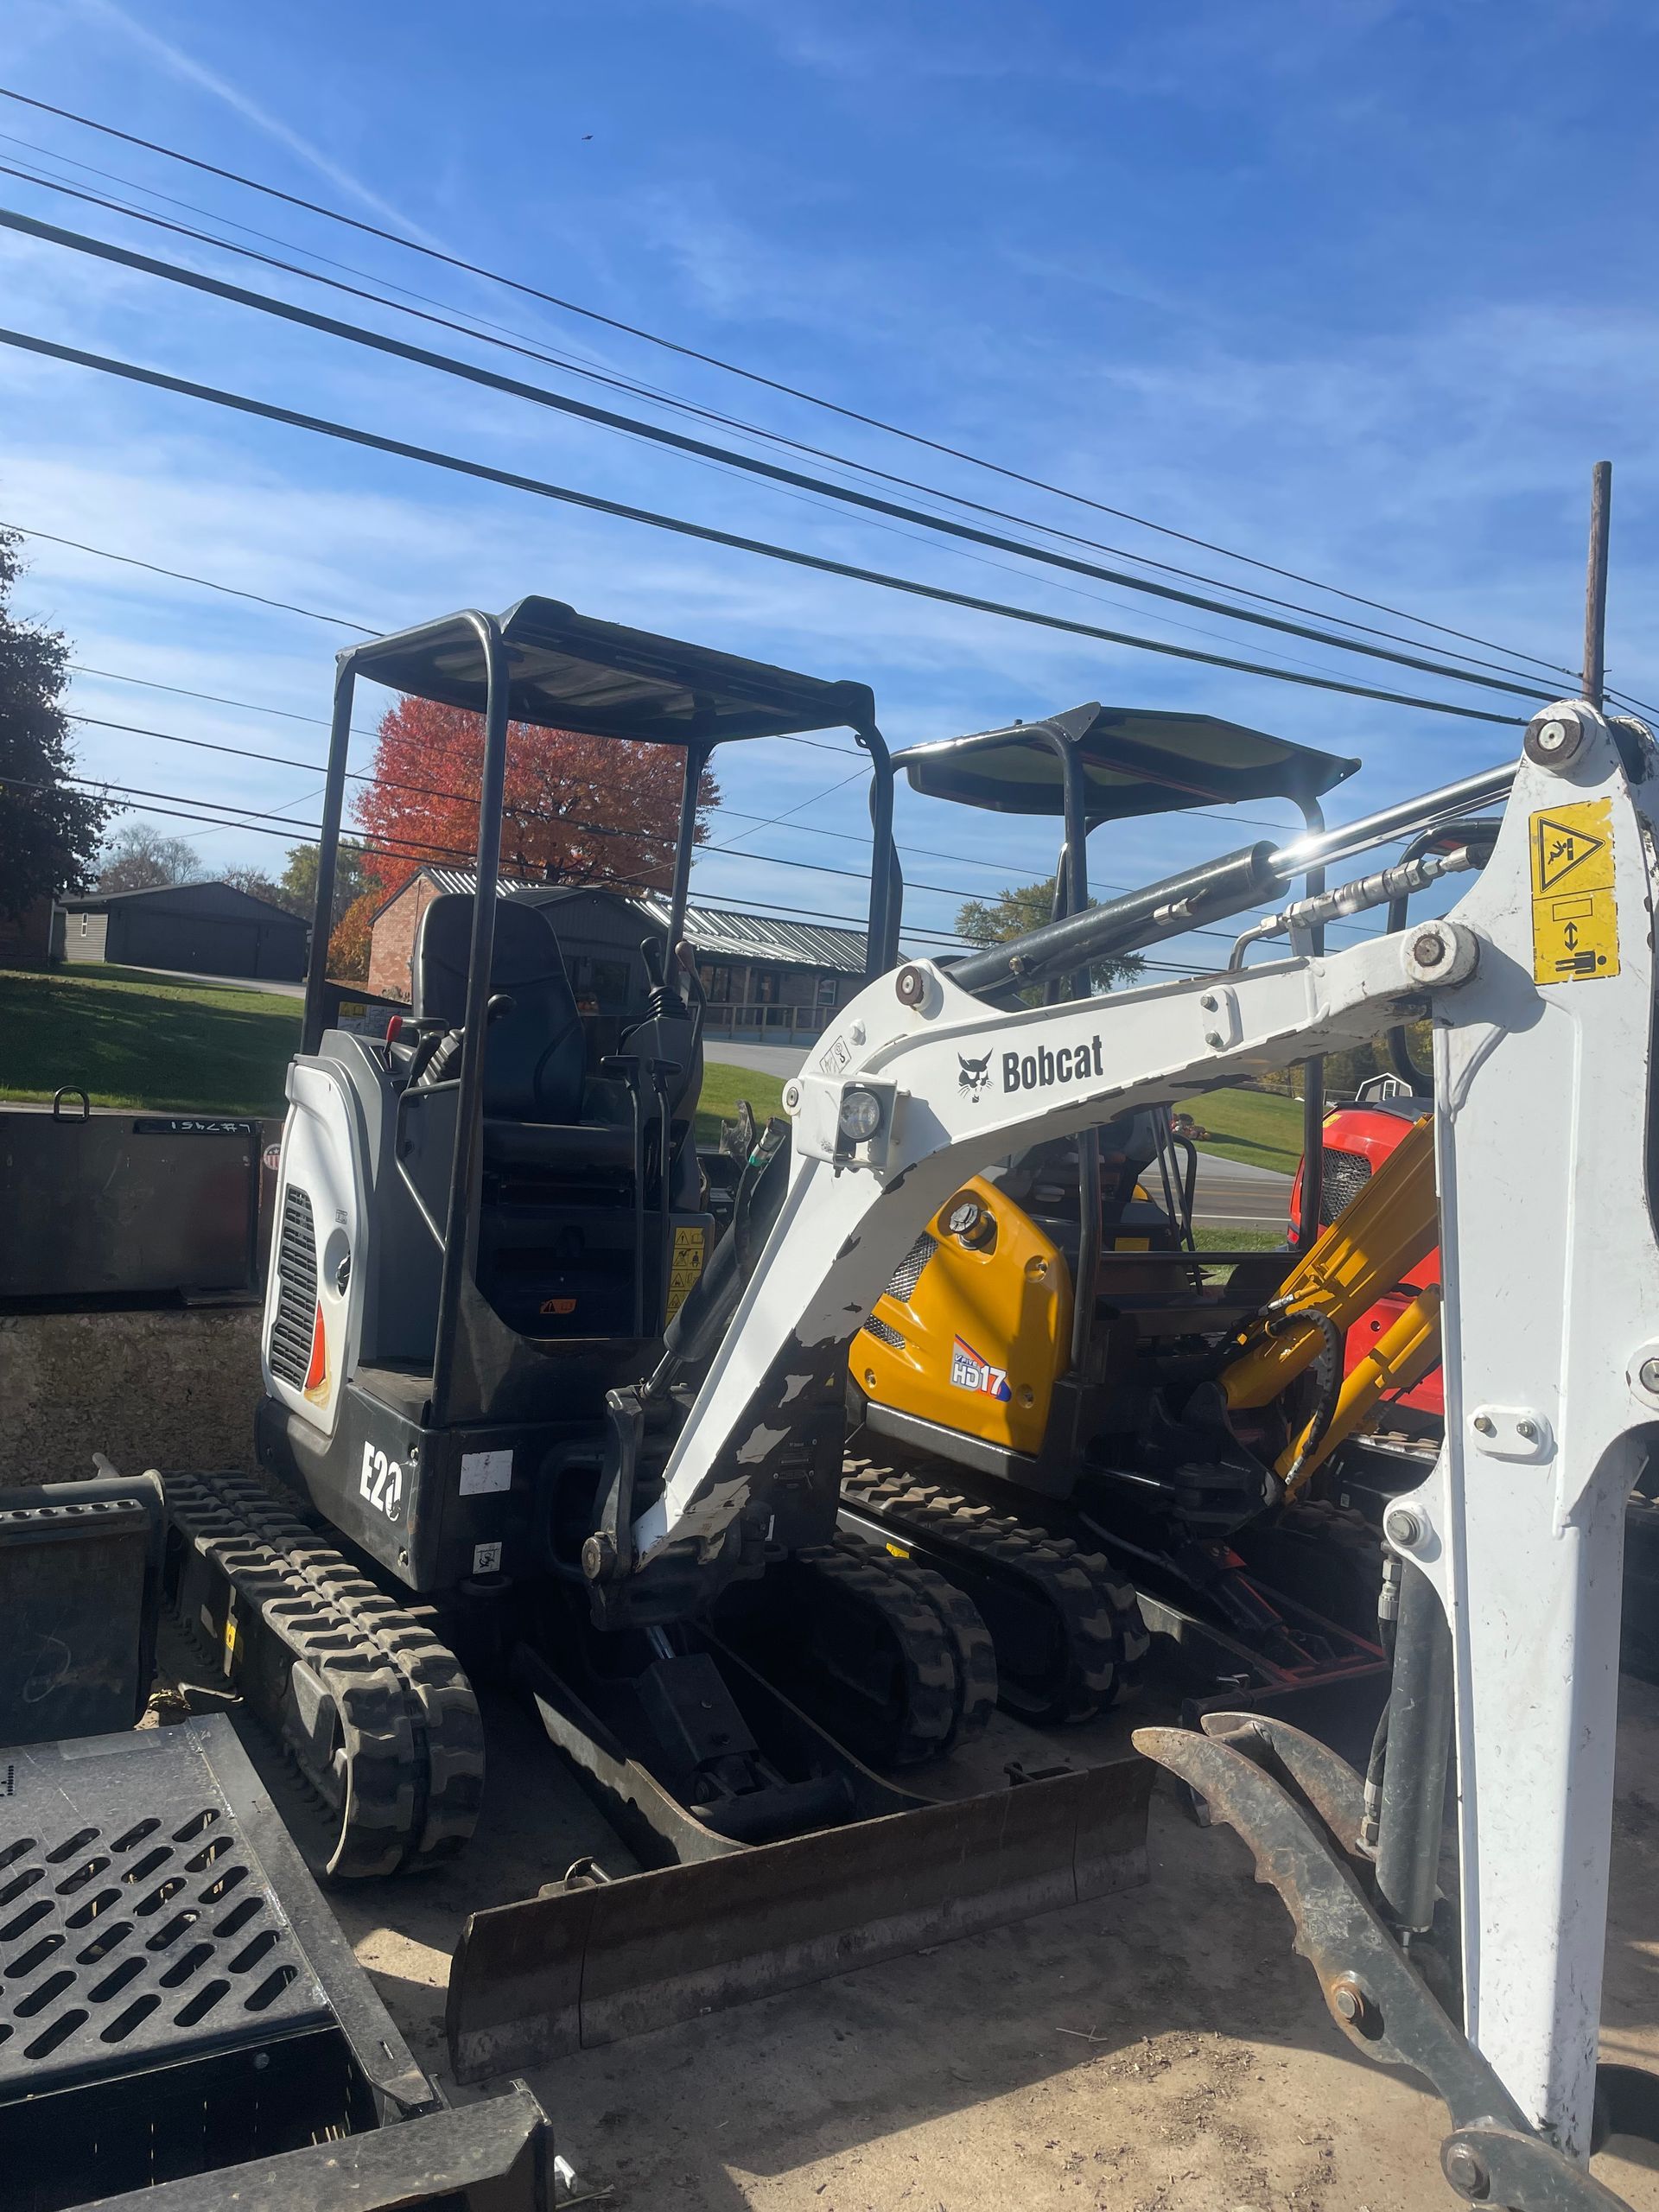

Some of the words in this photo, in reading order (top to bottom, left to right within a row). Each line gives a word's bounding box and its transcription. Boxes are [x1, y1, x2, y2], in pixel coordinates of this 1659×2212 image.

[1002, 1035, 1103, 1093] Bobcat
[952, 1363, 1007, 1396] HD17
[359, 1440, 403, 1522] E20
